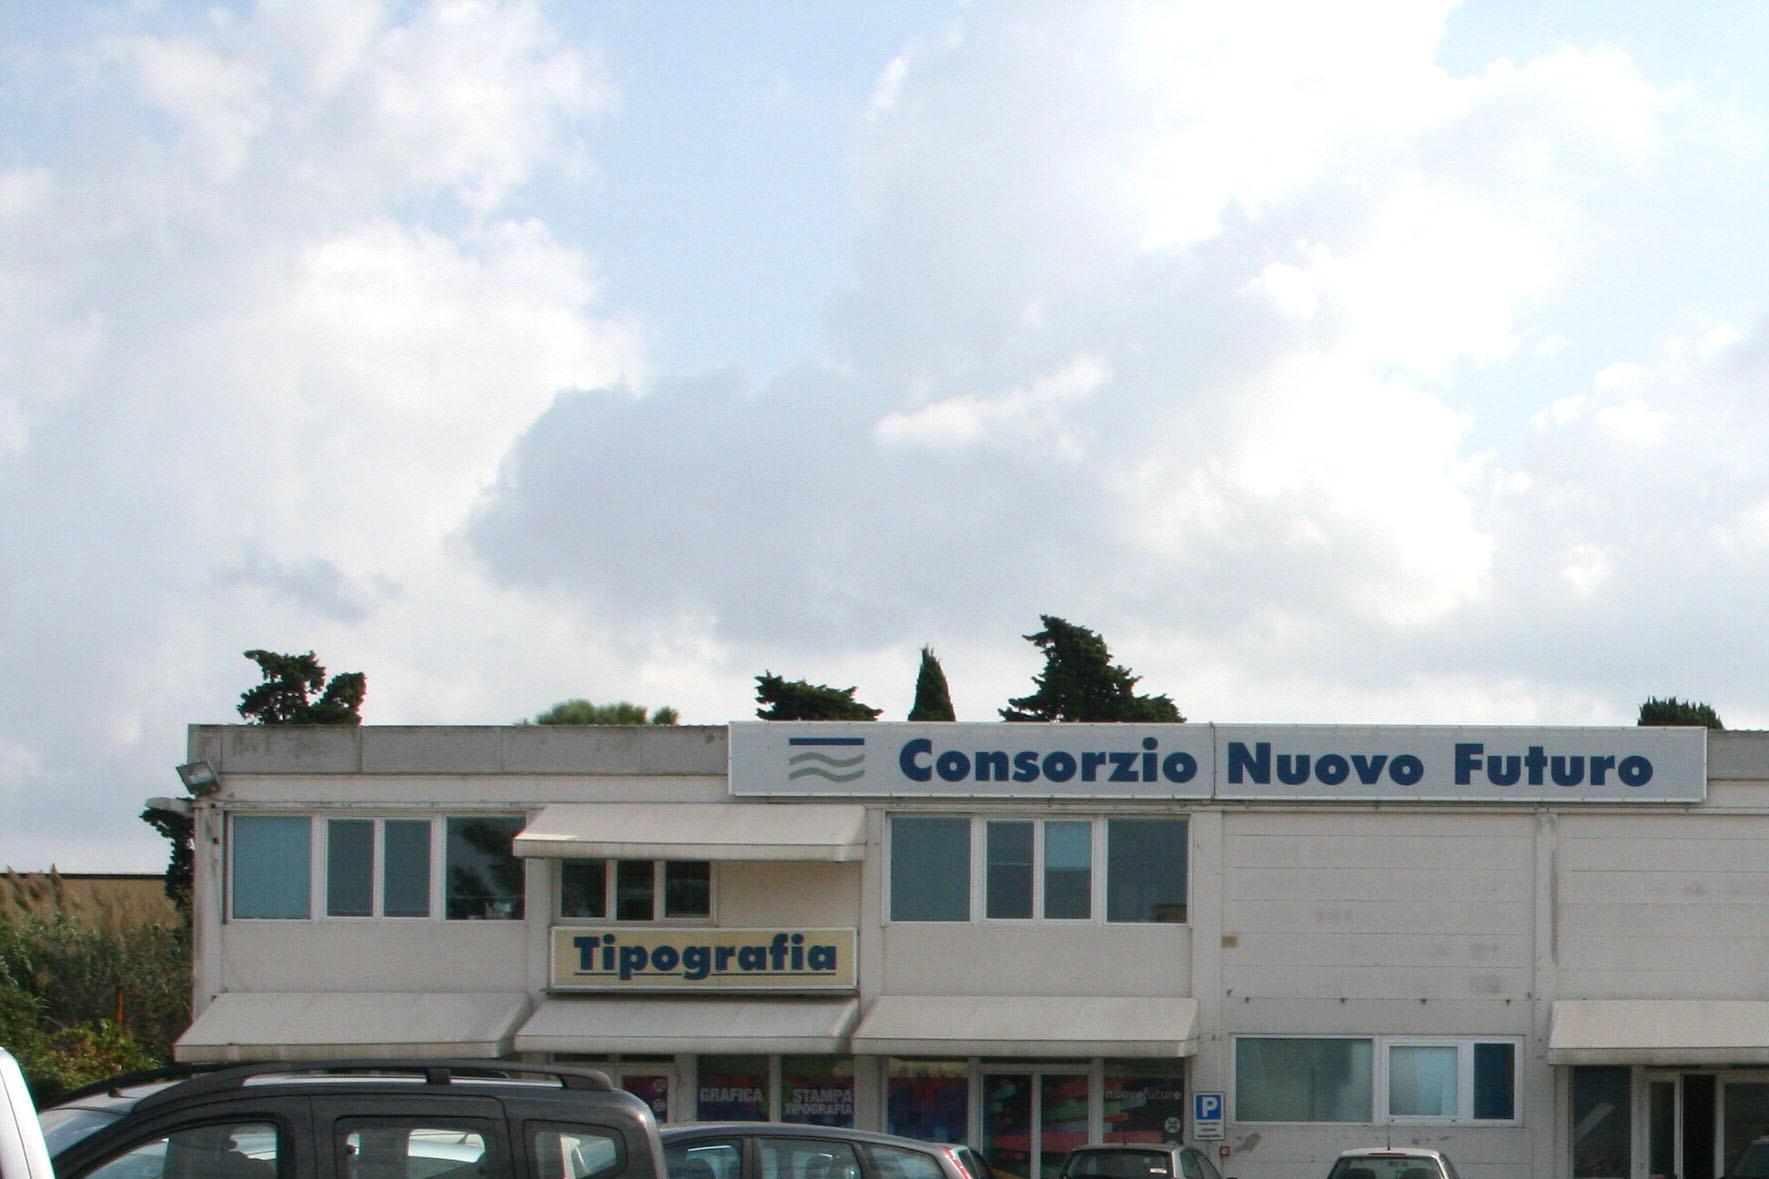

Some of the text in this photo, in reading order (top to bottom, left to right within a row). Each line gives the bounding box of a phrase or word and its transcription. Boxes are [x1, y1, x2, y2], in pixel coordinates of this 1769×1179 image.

[899, 736, 1653, 788] Consorzio Nuovo Futuro
[574, 933, 837, 979] Tipografia
[700, 1087, 763, 1102] GRAFICA
[793, 1088, 852, 1102] STAMPA
[785, 1103, 853, 1115] TIPOGRAFIA
[1202, 1096, 1218, 1118] P
